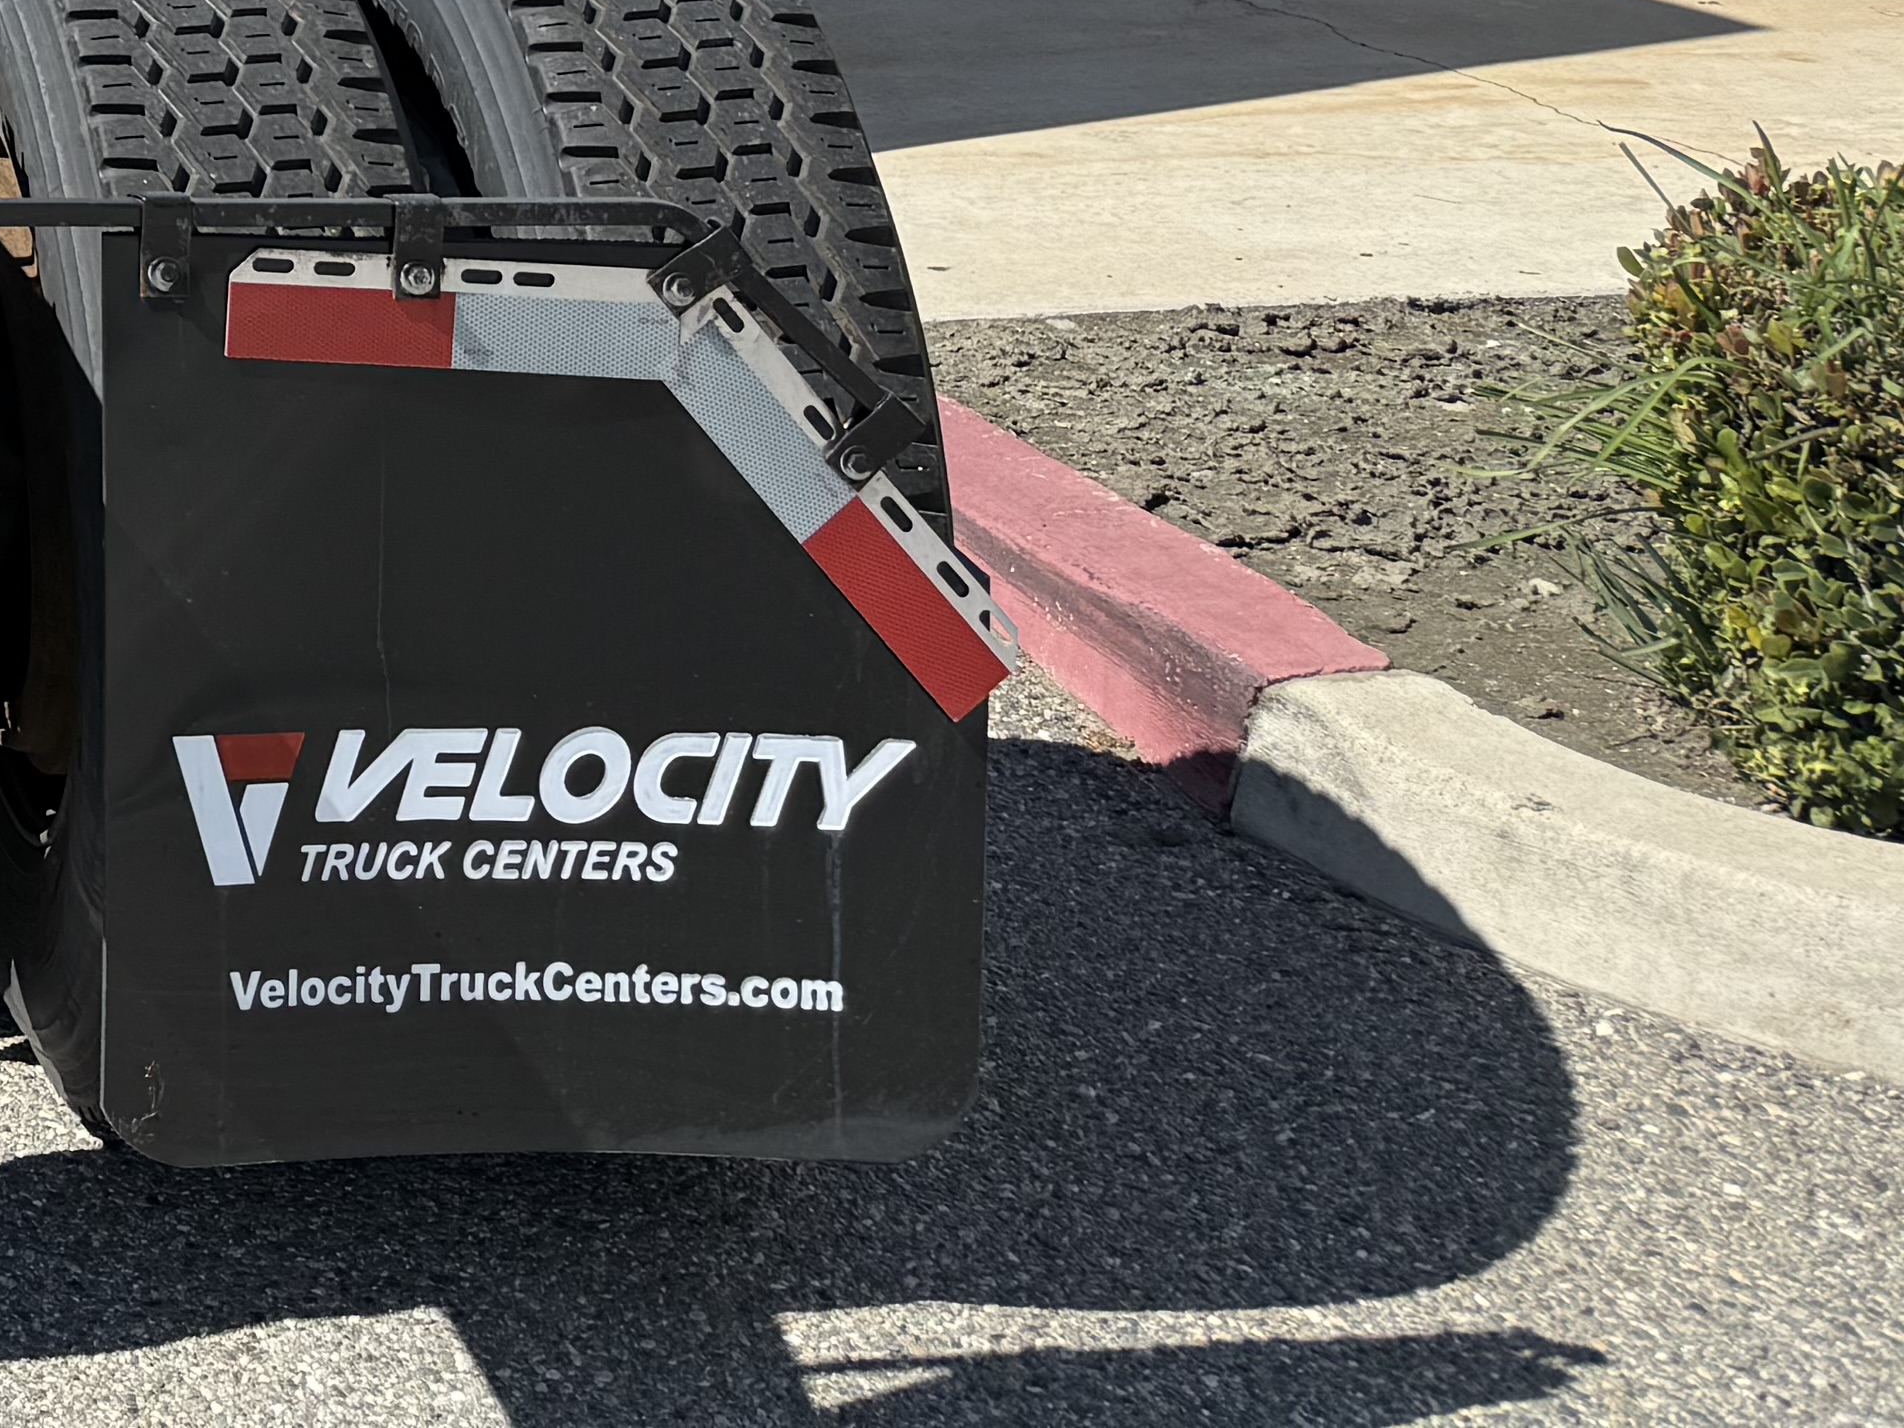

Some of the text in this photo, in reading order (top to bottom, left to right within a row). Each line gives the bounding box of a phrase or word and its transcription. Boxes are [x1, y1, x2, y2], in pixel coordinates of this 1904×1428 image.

[314, 725, 918, 838] VELOCITY
[300, 839, 679, 883] TRUCK CENTERS
[229, 960, 845, 1014] VelocityTruckCenters.com
